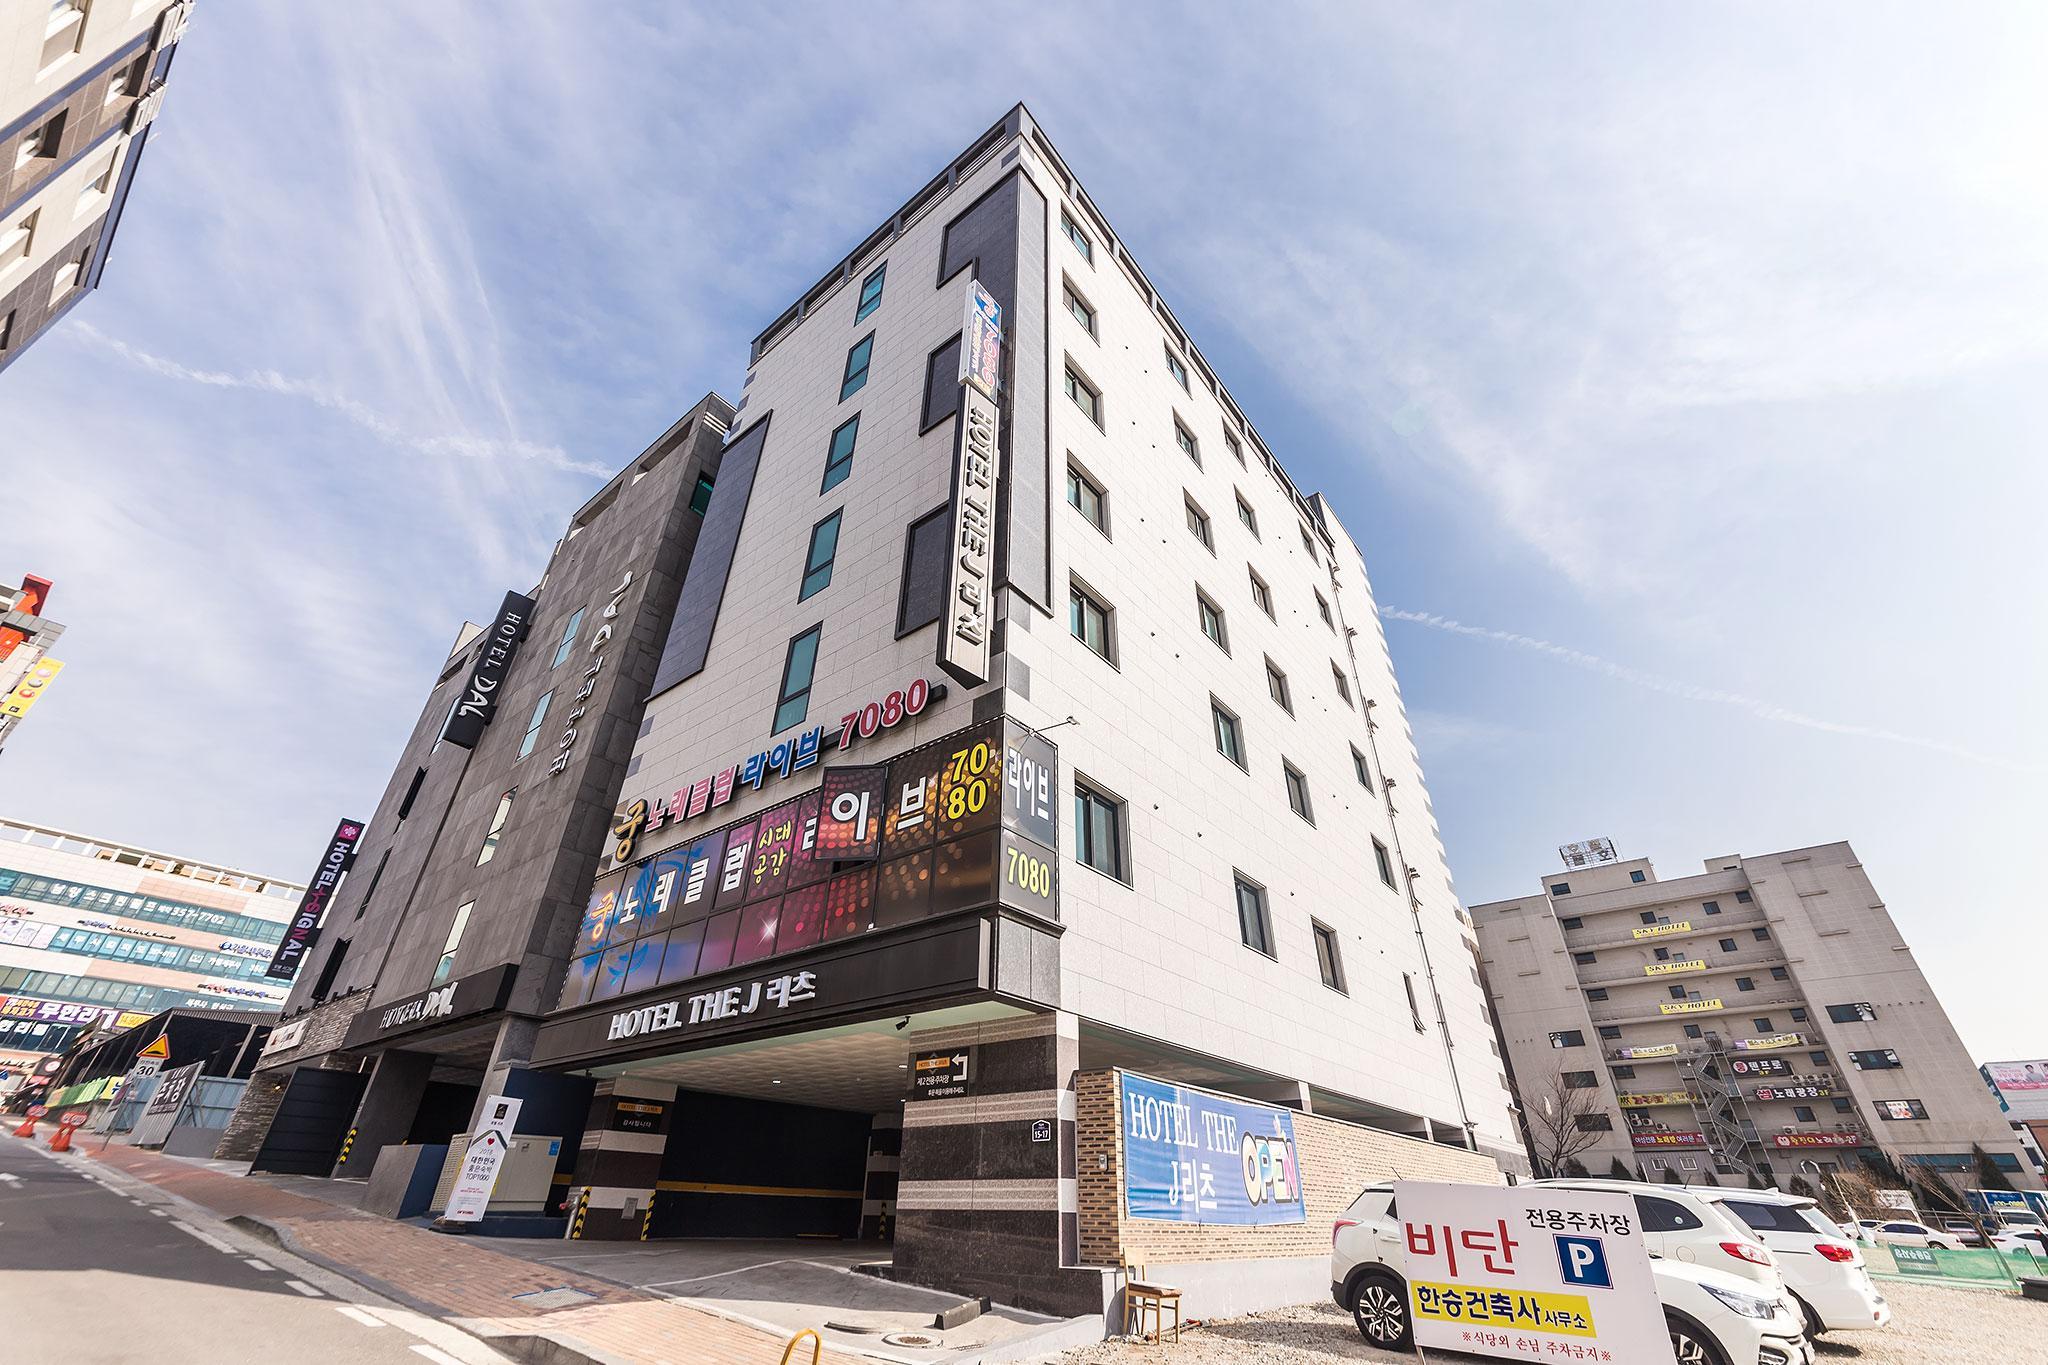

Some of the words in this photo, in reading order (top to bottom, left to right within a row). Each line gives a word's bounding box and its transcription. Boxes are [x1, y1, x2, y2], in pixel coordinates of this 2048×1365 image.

[964, 405, 993, 490] HOTEL
[961, 495, 988, 557] THE
[485, 611, 522, 669] HOTEL
[457, 673, 498, 718] DAL
[548, 655, 604, 776] HOTEL
[644, 763, 739, 832] 노래클럽
[740, 726, 823, 790] 라이브
[838, 678, 930, 750] 7080
[950, 742, 990, 783] 70
[946, 777, 988, 821] 80
[1005, 745, 1050, 823] 라이브
[757, 820, 792, 852] 시대
[315, 840, 351, 889] HOTEL
[619, 838, 752, 925] 노래클럽
[752, 850, 788, 886] 공감
[1006, 847, 1051, 900] 7080
[279, 899, 321, 961] SIGNAL
[1635, 924, 1656, 935] SKY
[1657, 921, 1688, 932] HOTEL
[1648, 963, 1669, 973] SKY
[1670, 960, 1701, 970] HOTEL
[607, 998, 682, 1041] HOTEL
[688, 988, 742, 1024] THE
[1663, 1001, 1685, 1011] SKY
[1686, 999, 1718, 1010] HOTEL
[137, 1066, 154, 1076] 30
[1748, 1059, 1783, 1071] 텐프로
[1773, 1086, 1818, 1099] 노래광장
[1034, 1130, 1049, 1139] 15-17
[1128, 1090, 1199, 1149] HOTEL
[1201, 1109, 1239, 1153] THE
[470, 1156, 496, 1166] 대한민국
[1240, 1131, 1300, 1209] OPEN
[1168, 1158, 1218, 1214] J리츠
[1525, 1207, 1631, 1236] 전용주차장
[1405, 1219, 1519, 1277] 비단
[1570, 1242, 1595, 1278] P
[1416, 1285, 1541, 1326] 한승건축사
[1543, 1310, 1588, 1330] 사무소
[1515, 1334, 1541, 1354] 손님
